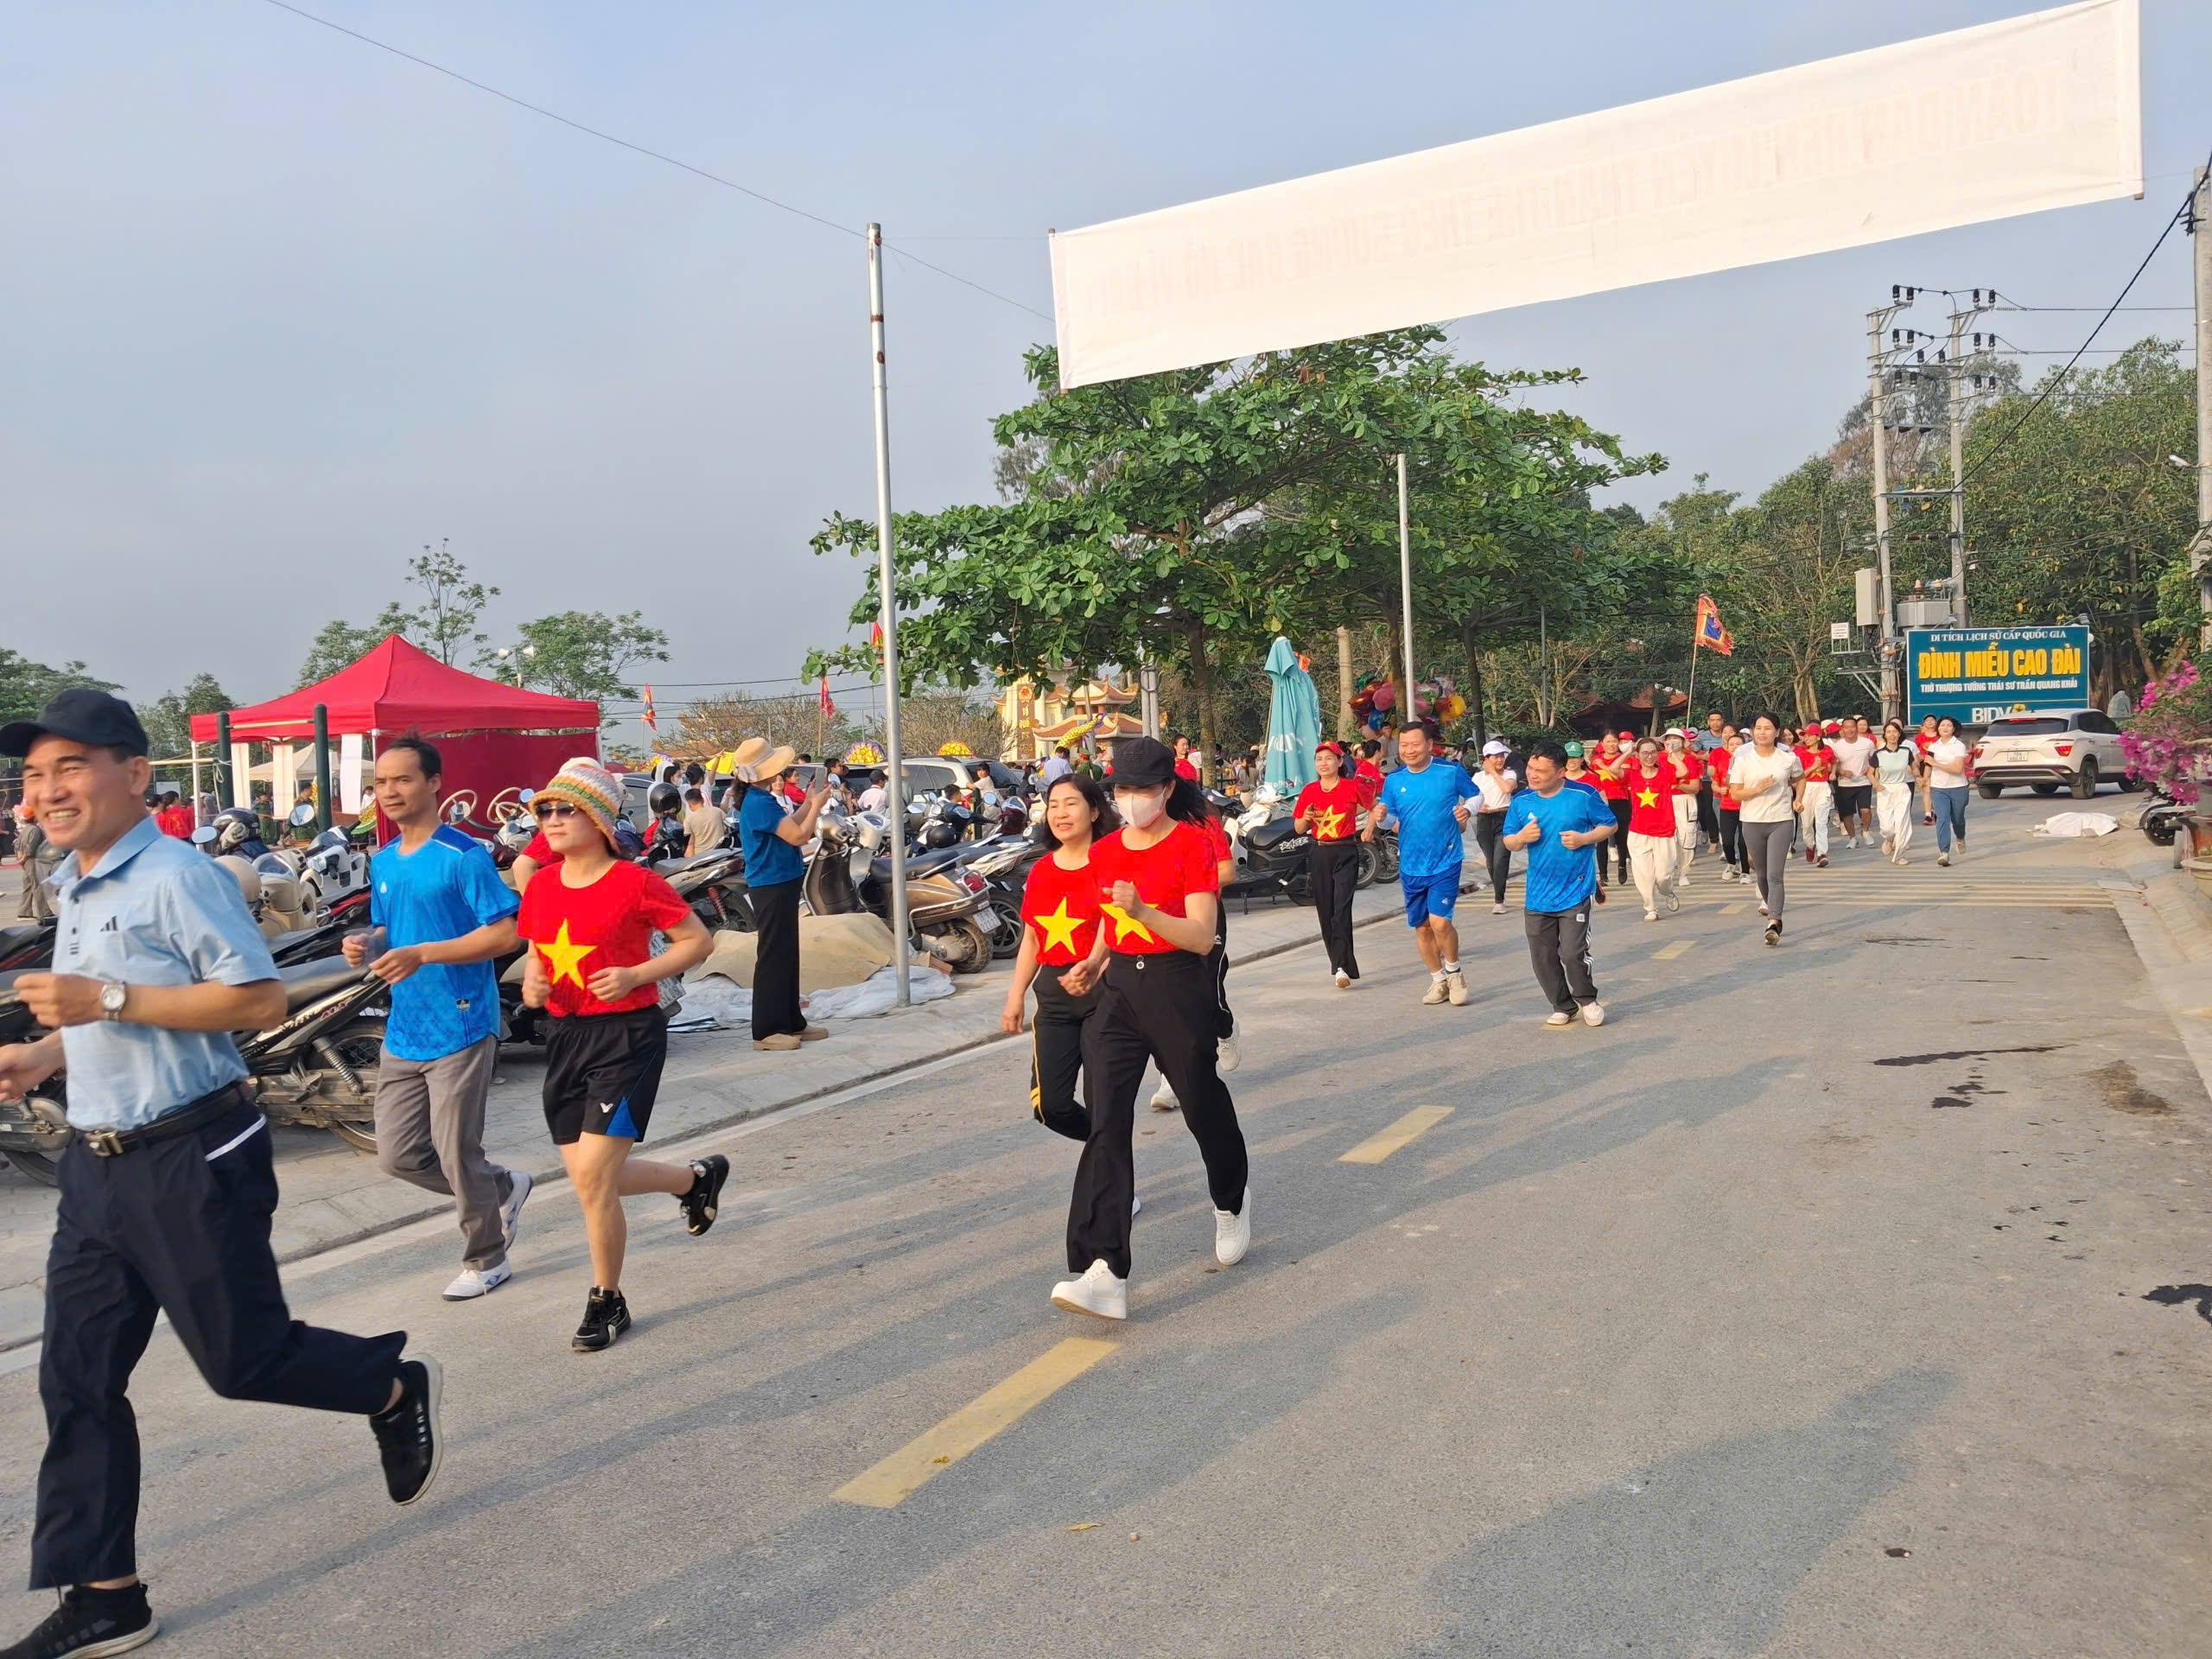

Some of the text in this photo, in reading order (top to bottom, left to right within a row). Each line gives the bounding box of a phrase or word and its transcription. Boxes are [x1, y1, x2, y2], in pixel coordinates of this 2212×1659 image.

[1942, 632, 1964, 642] TÍCH
[1966, 632, 1987, 643] LỊCH
[1989, 631, 2001, 640] SỬ
[2002, 630, 2021, 640] CẤP
[2022, 628, 2048, 640] QUỐC
[2049, 630, 2067, 639] GIA
[1918, 647, 1961, 679] ĐÌNH
[2012, 649, 2048, 676] CAO
[2051, 644, 2081, 676] ĐÀI
[1987, 680, 2005, 691] THÁI
[2036, 679, 2060, 690] QUANG
[1972, 706, 2012, 723] BIDV
